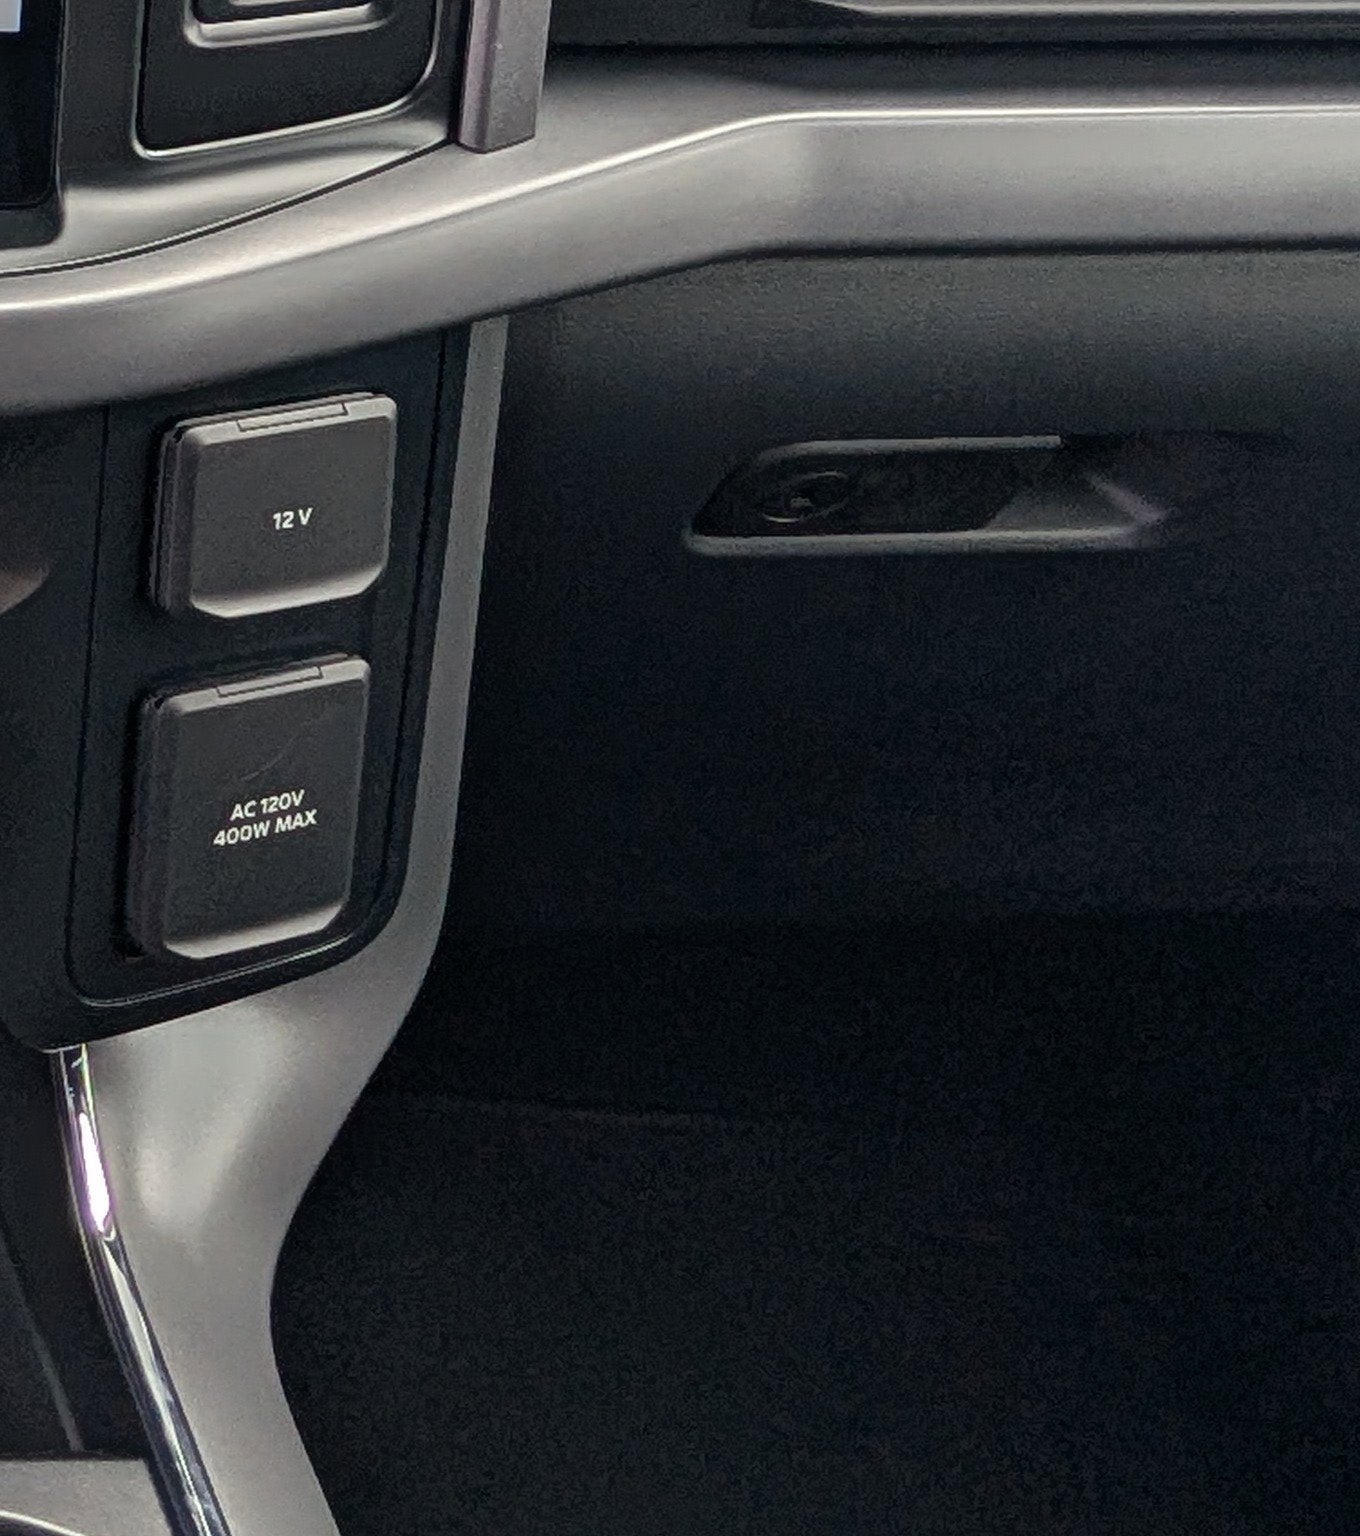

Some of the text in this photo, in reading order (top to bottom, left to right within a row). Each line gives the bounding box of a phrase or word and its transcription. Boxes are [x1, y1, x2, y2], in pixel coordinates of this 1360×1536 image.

[273, 507, 314, 531] 12 V
[230, 789, 306, 822] AC 120V
[213, 808, 318, 846] 400W MAX
